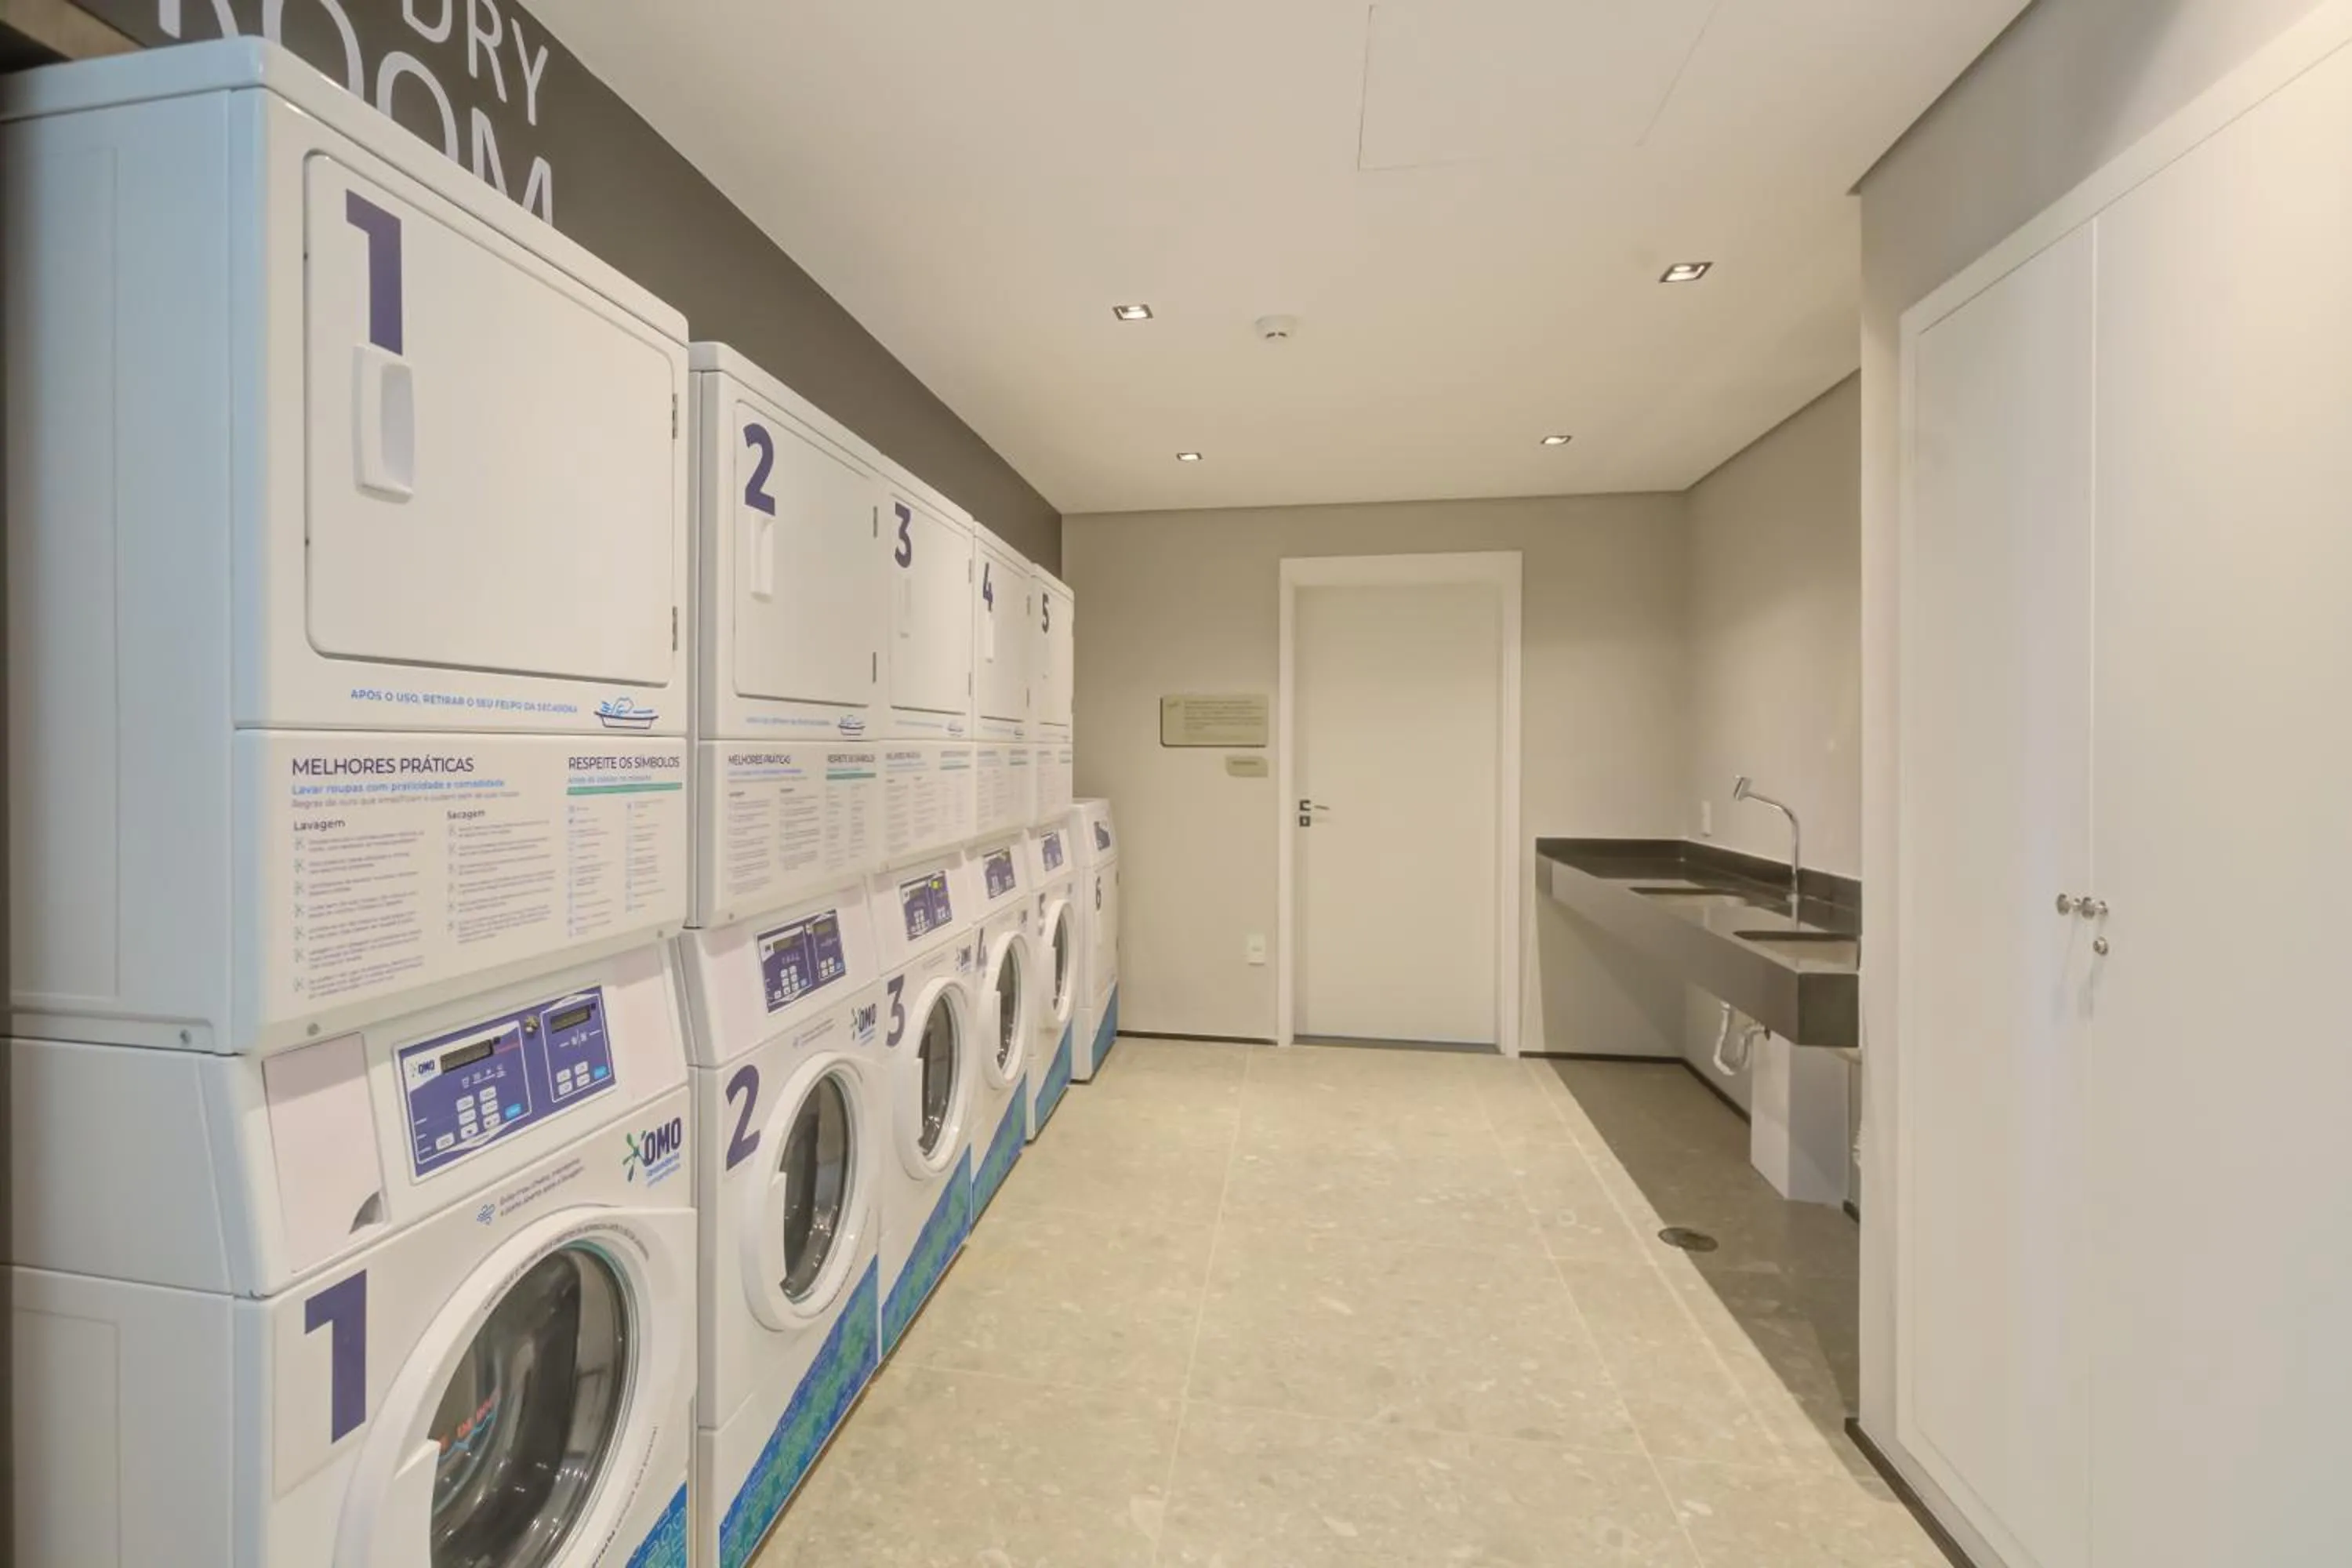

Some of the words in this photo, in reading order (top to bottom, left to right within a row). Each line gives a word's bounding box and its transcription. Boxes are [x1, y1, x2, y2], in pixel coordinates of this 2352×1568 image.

[346, 188, 404, 356] 1
[742, 423, 775, 516] 2
[894, 502, 912, 568] 3
[982, 562, 993, 612] 4
[1041, 593, 1050, 633] 5
[292, 757, 395, 776] MELHORES
[400, 754, 474, 773] PRÁTICAS
[568, 756, 617, 771] RESPEITE
[619, 756, 633, 770] OS
[293, 818, 346, 832] Lavagem
[1095, 875, 1102, 912] 6
[886, 974, 906, 1047] 3
[643, 1116, 681, 1167] OMO
[726, 1064, 761, 1172] 2
[304, 1269, 367, 1444] 1
